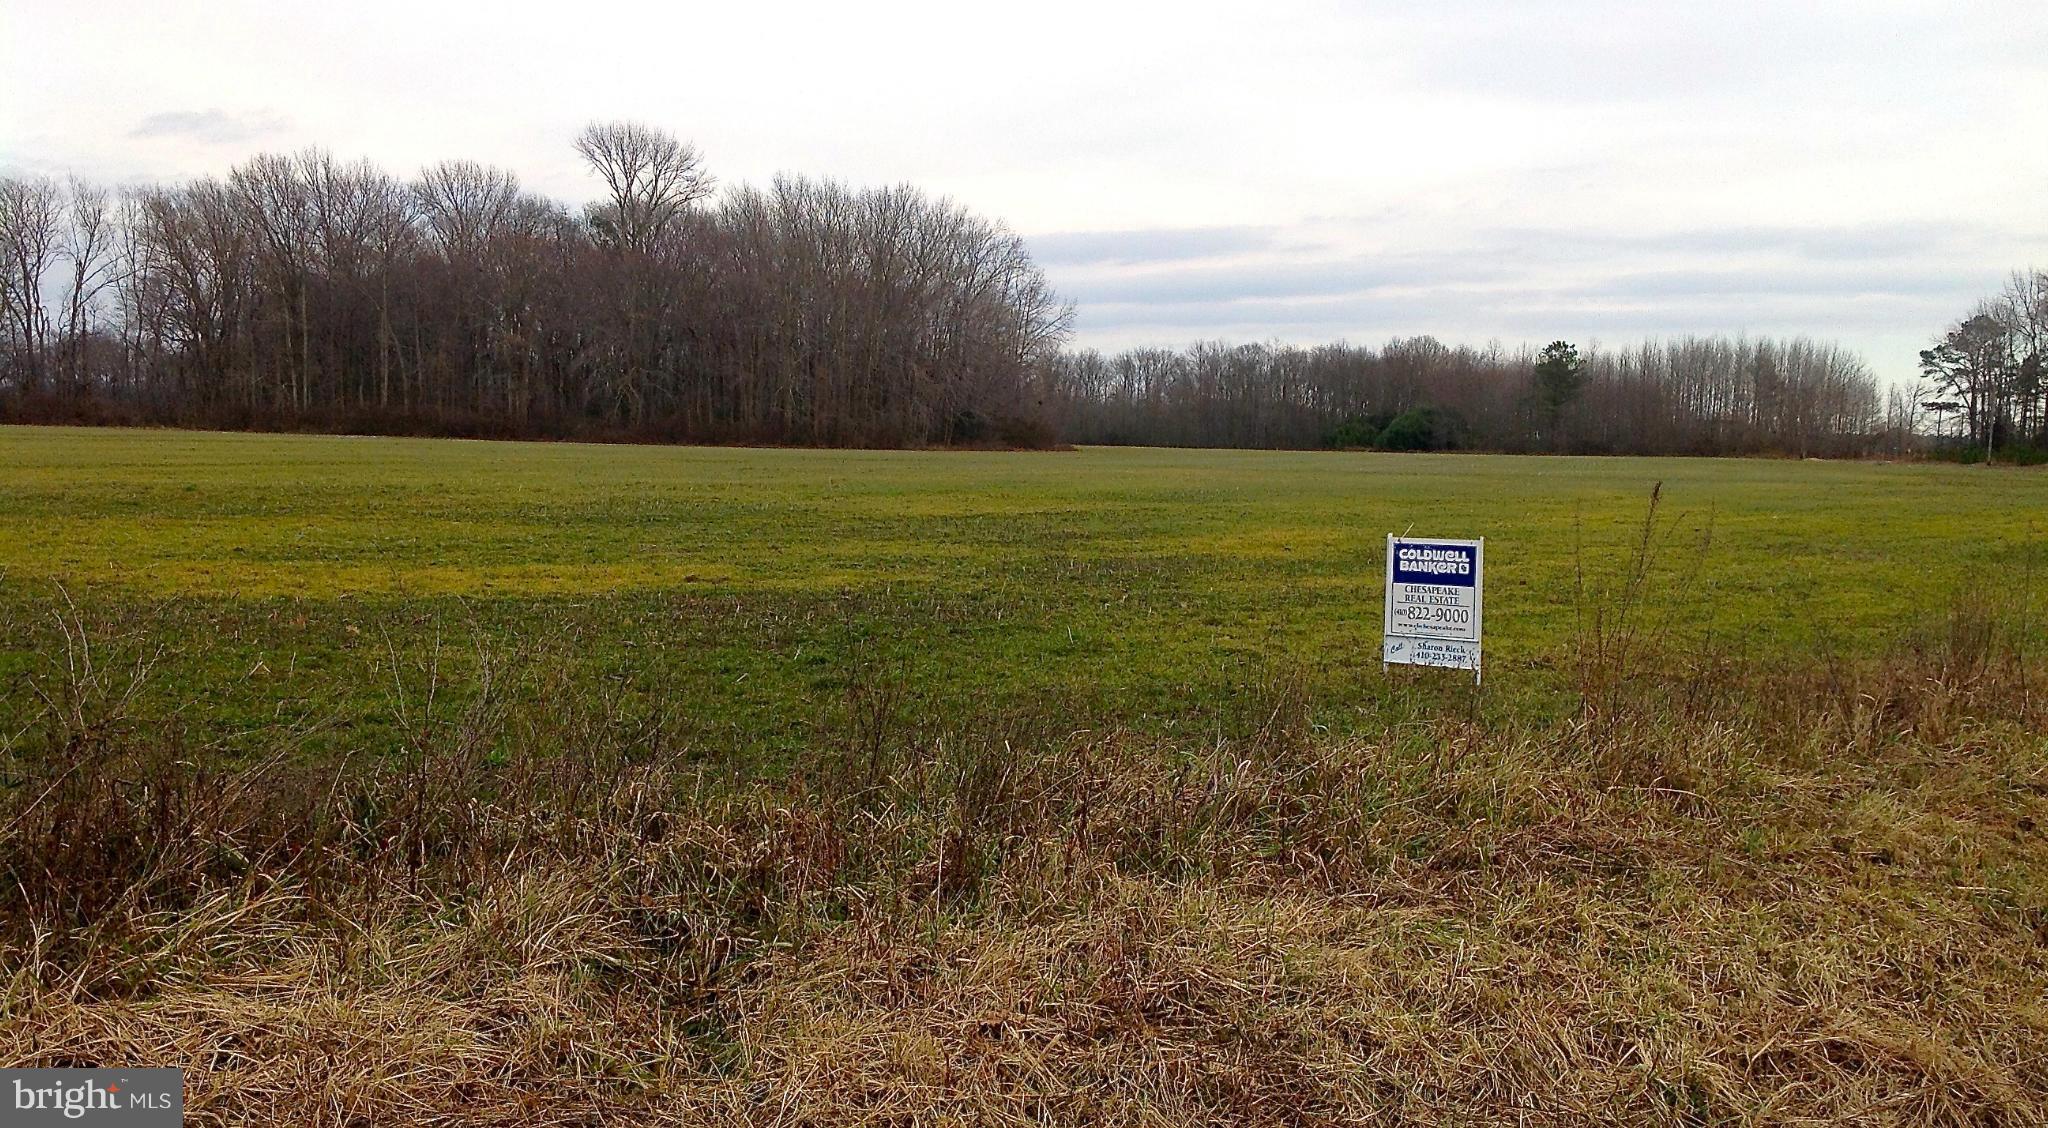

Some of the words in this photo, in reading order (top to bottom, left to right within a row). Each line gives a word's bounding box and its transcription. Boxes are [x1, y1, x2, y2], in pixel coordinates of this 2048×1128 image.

[1404, 585, 1459, 595] CHESAPEAKE
[1404, 595, 1425, 603] REAL
[1429, 595, 1459, 604] ESTATE
[1407, 606, 1469, 623] 822-9000
[1417, 643, 1443, 651] Sharon
